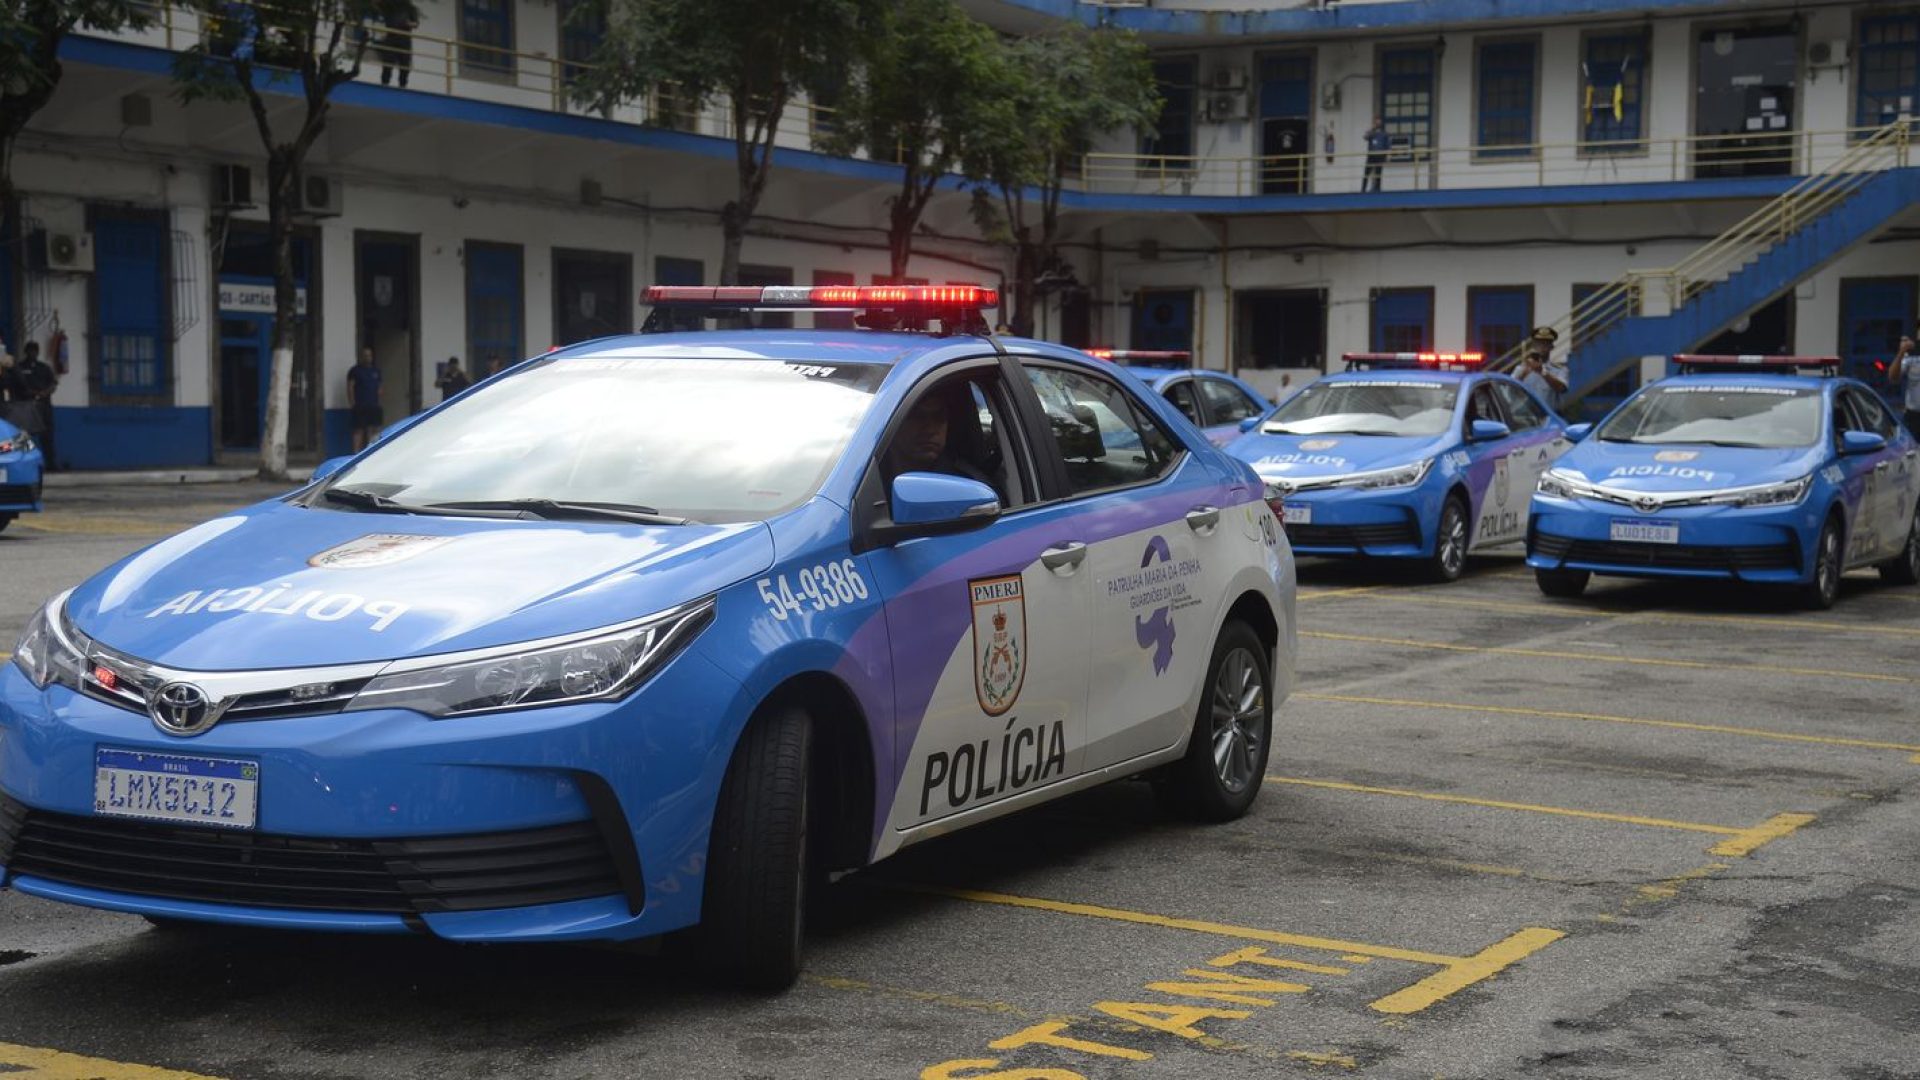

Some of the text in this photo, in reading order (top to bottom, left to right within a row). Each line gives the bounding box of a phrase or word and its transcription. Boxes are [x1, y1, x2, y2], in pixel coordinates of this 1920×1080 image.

[1259, 514, 1277, 548] 190
[756, 558, 868, 621] 54-9386
[974, 582, 1019, 602] PMERJ
[1108, 559, 1201, 596] PATRULHA MARIA DA PENHA
[1130, 587, 1163, 609] GUARDIÕES
[1163, 587, 1172, 600] DA
[1172, 583, 1186, 595] VIDA
[919, 716, 1066, 817] POLÍCIA
[109, 771, 237, 819] LMX5C12
